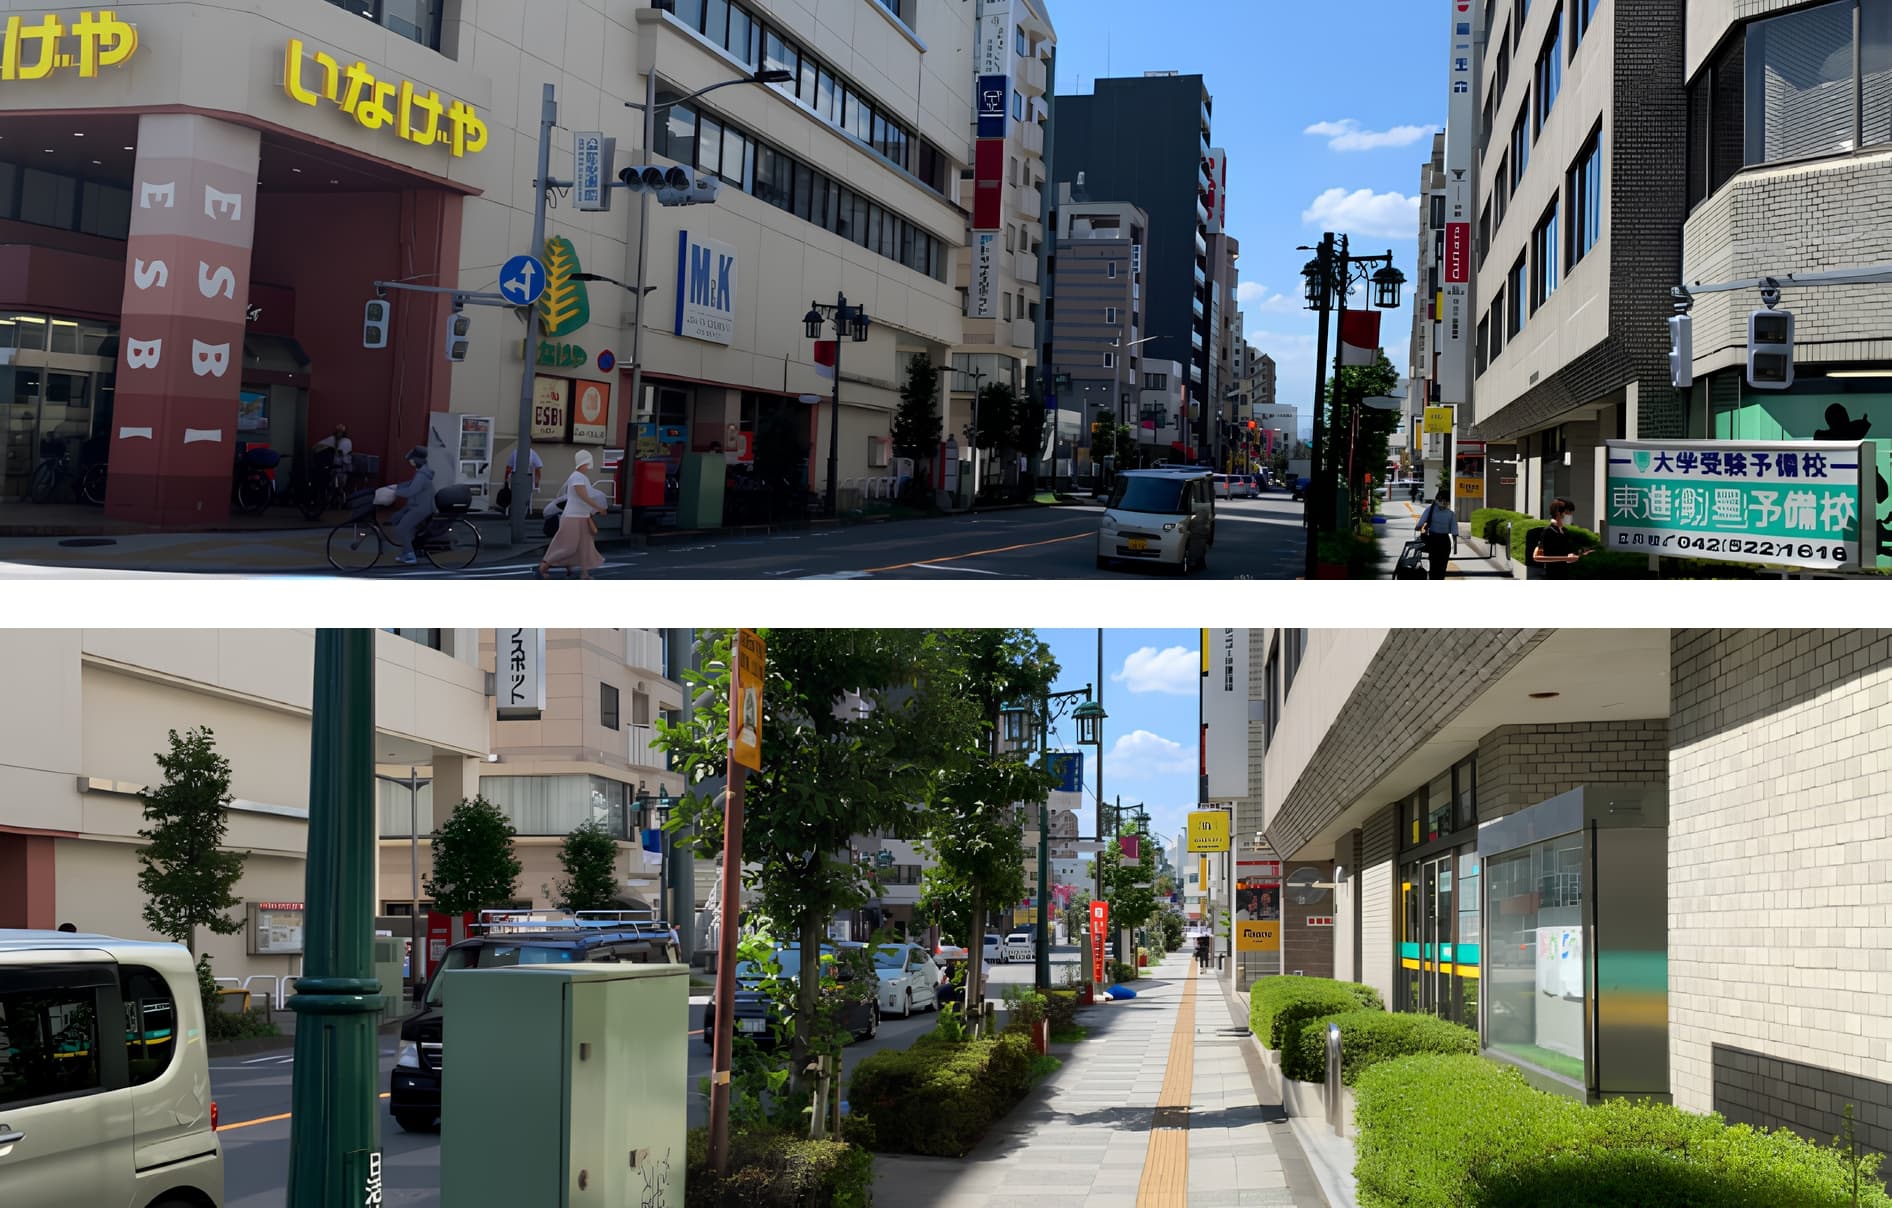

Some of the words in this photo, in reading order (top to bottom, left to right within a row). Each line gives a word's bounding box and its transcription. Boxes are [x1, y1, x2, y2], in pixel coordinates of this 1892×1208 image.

[284, 38, 488, 158] いなげや
[1653, 450, 1827, 479] 大学受験予備校
